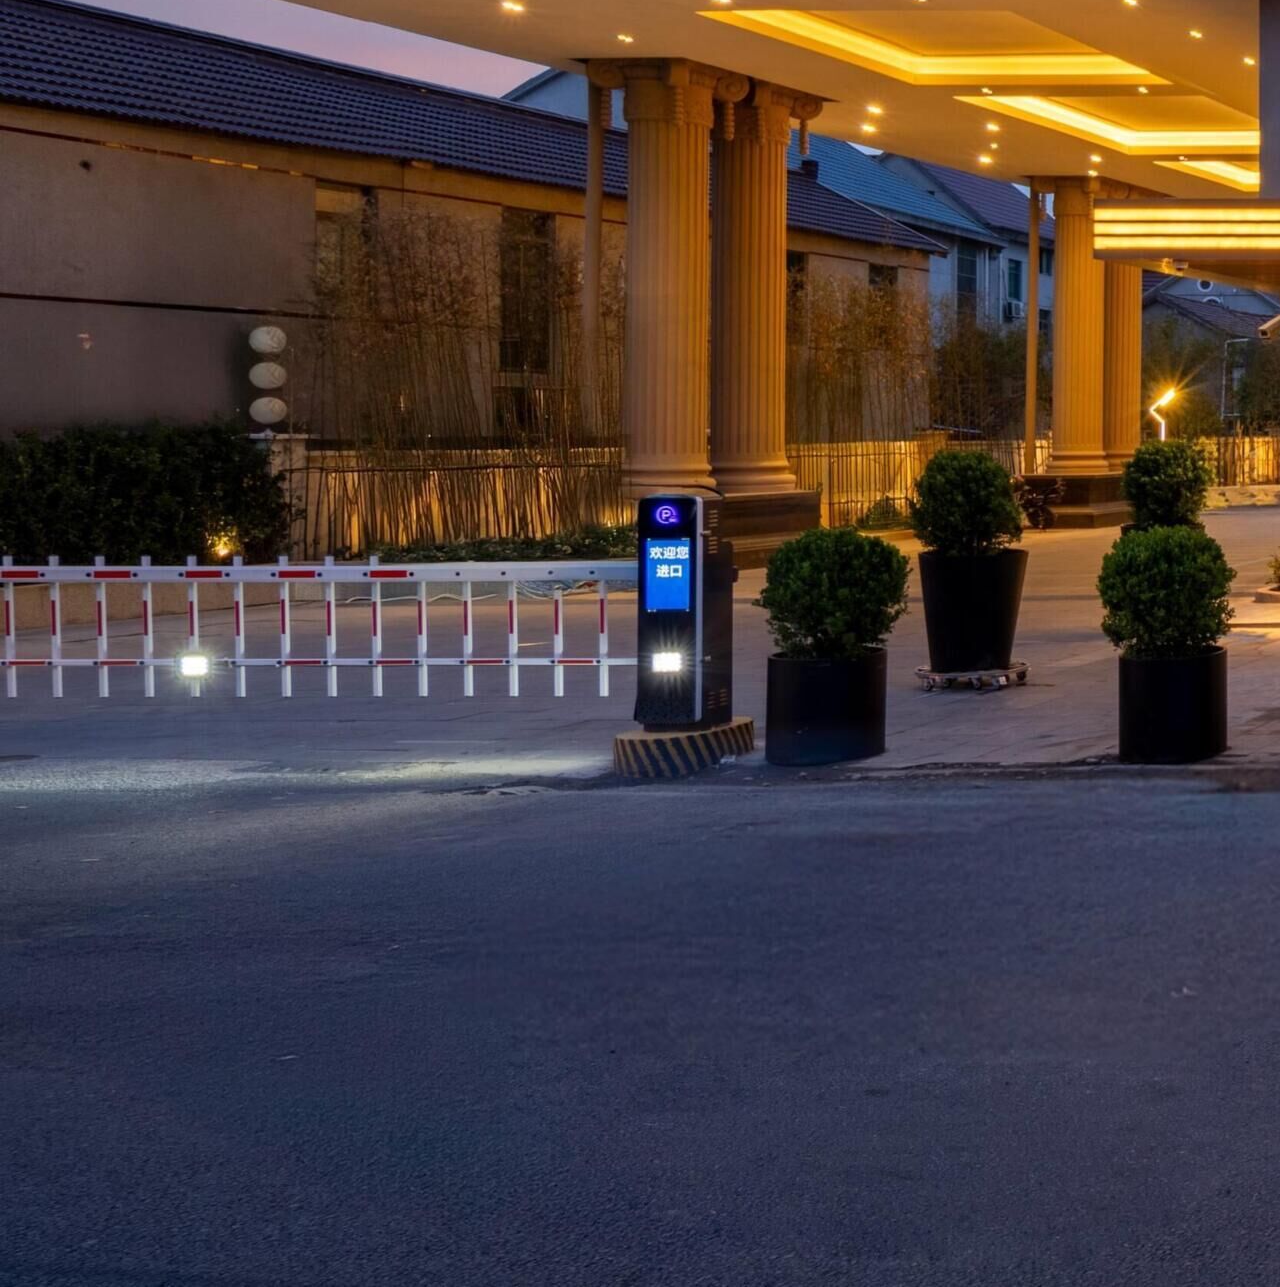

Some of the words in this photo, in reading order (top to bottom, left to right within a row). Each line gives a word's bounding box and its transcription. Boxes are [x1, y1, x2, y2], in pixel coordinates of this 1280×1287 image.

[649, 545, 690, 560] 欢迎您
[655, 564, 683, 578] 进口
